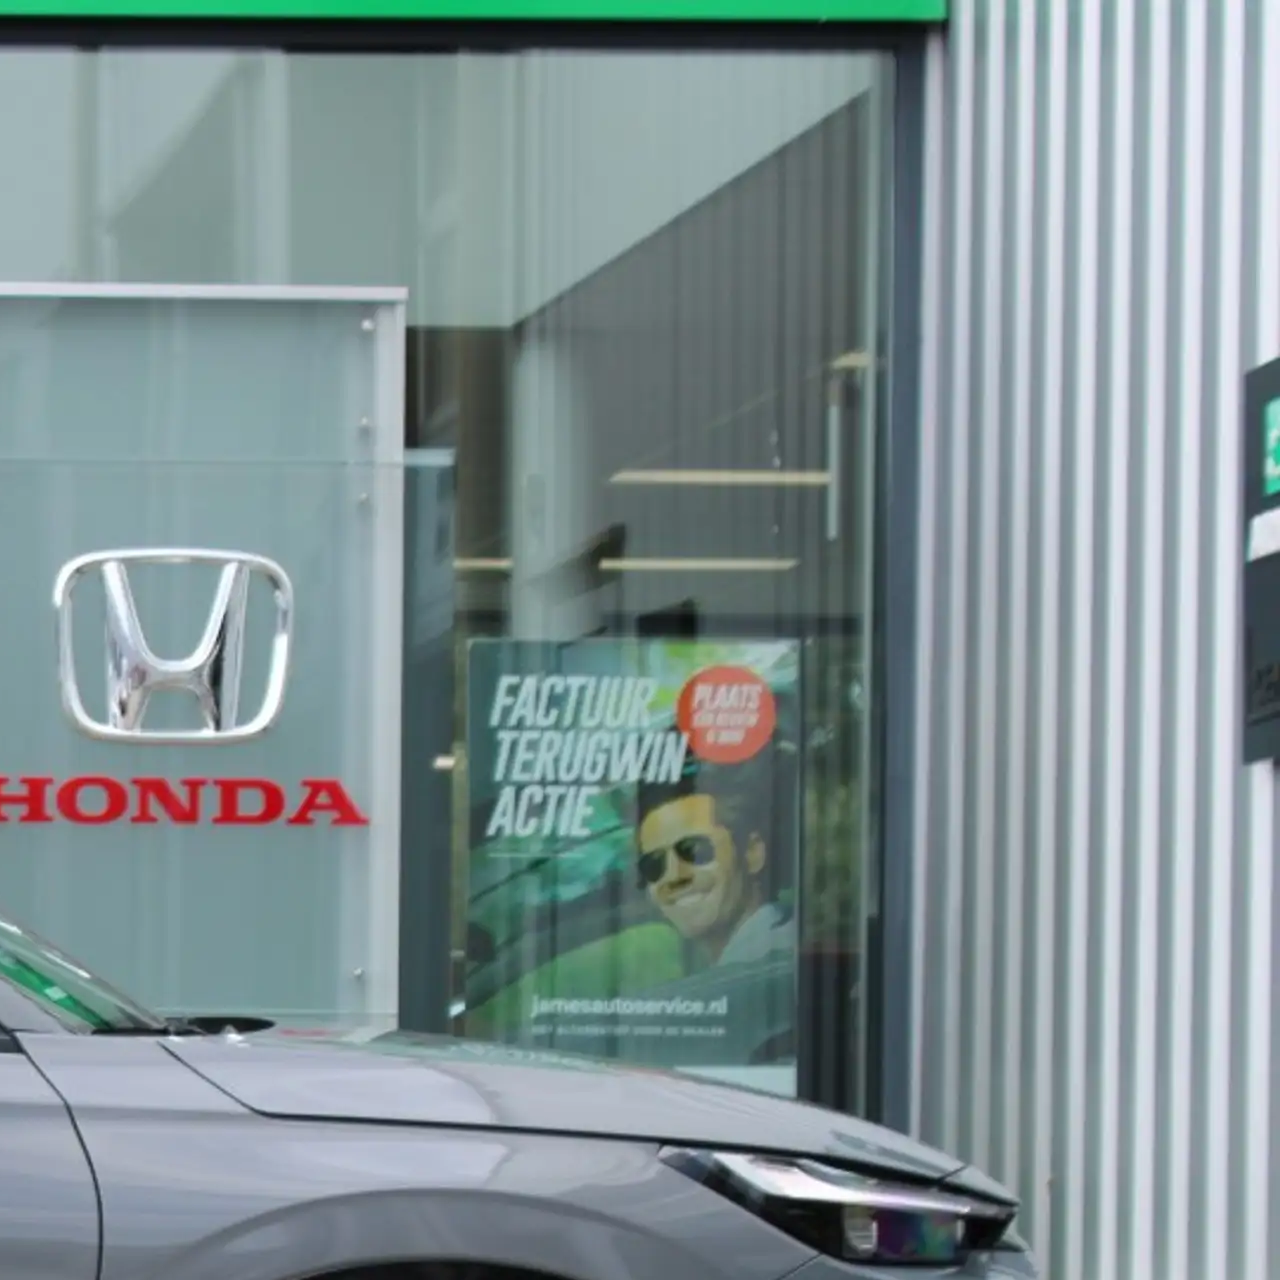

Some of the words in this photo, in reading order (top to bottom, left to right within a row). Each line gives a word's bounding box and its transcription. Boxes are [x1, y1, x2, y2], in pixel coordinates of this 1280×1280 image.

[491, 675, 656, 728] FACTUUR
[692, 683, 762, 711] PLAATS
[493, 730, 689, 784] TERUGWIN
[487, 786, 597, 837] ACTIE
